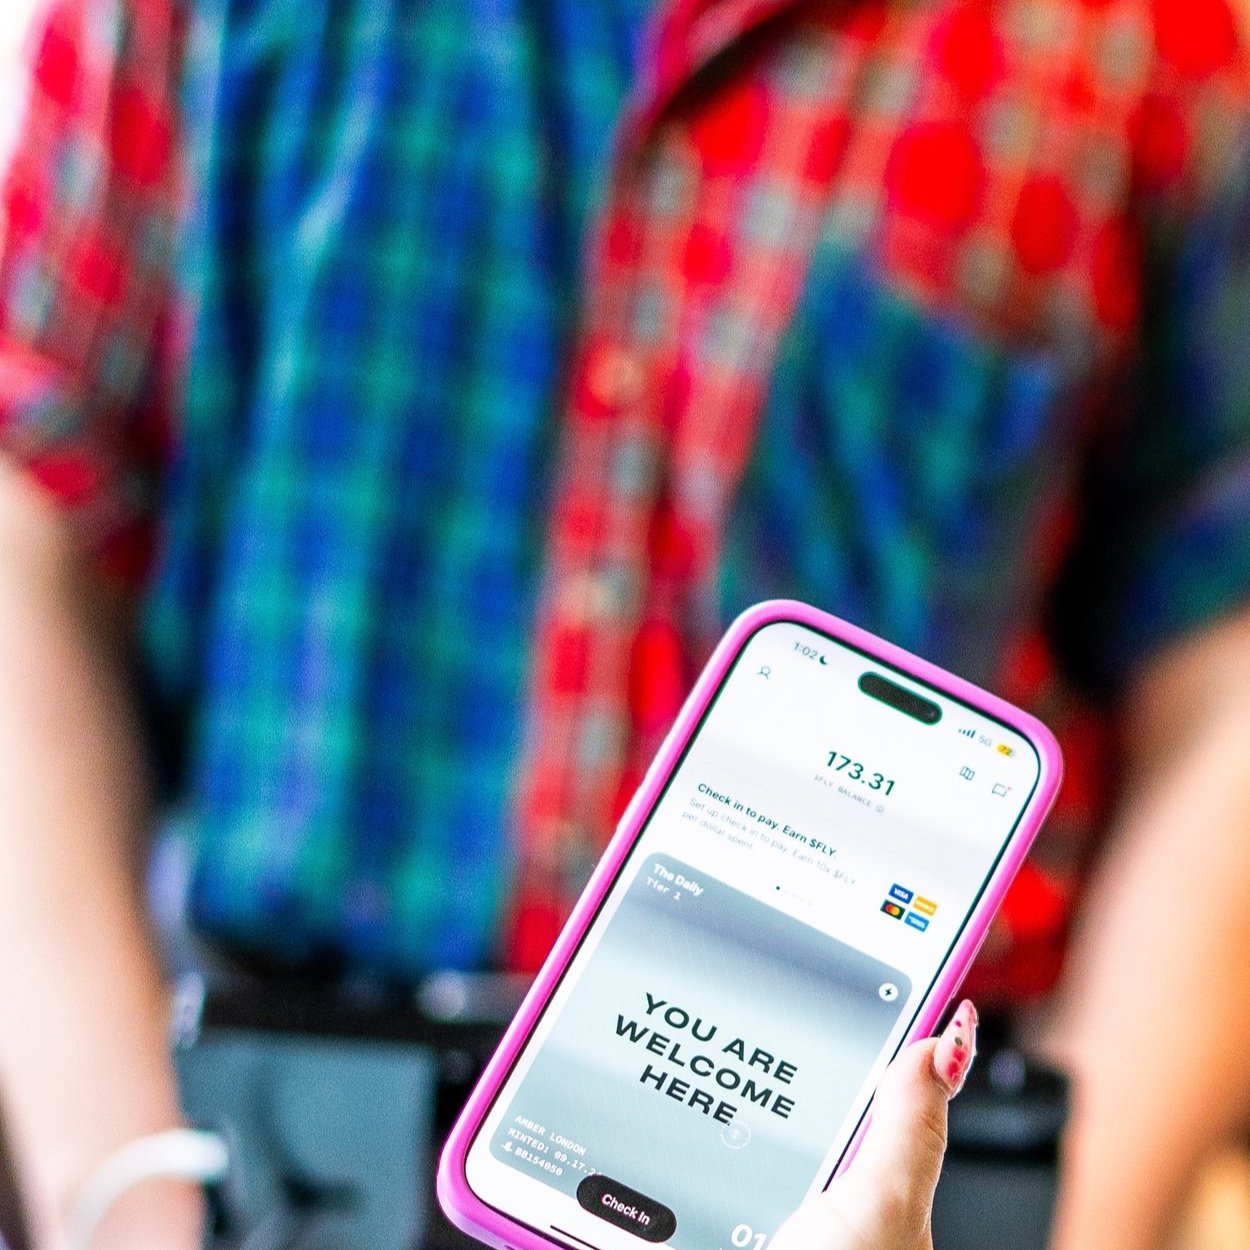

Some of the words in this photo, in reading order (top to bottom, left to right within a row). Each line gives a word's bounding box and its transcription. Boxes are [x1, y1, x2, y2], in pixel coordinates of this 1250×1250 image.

[793, 641, 818, 661] 1:02
[979, 735, 992, 747] 5G
[826, 751, 896, 796] 173.31
[698, 782, 731, 806] Check
[733, 800, 744, 812] in
[745, 806, 757, 819] to
[782, 824, 807, 844] Earn
[837, 786, 872, 807] BALANCE
[681, 810, 697, 822] per
[689, 798, 705, 812] Set
[707, 807, 718, 819] up
[720, 813, 747, 832] check
[646, 876, 670, 894] Tier
[653, 862, 675, 881] The
[674, 874, 704, 897] Daily
[644, 991, 717, 1043] YOU
[721, 1037, 798, 1085] ARE
[614, 1014, 796, 1120] WELCOME
[639, 1064, 738, 1127] HERE
[507, 1127, 549, 1154] MINTED:
[554, 1151, 603, 1176] 09.17.2
[514, 1115, 546, 1136] AMBER
[549, 1133, 587, 1157] LONDON
[601, 1193, 639, 1219] Check
[638, 1211, 651, 1226] In
